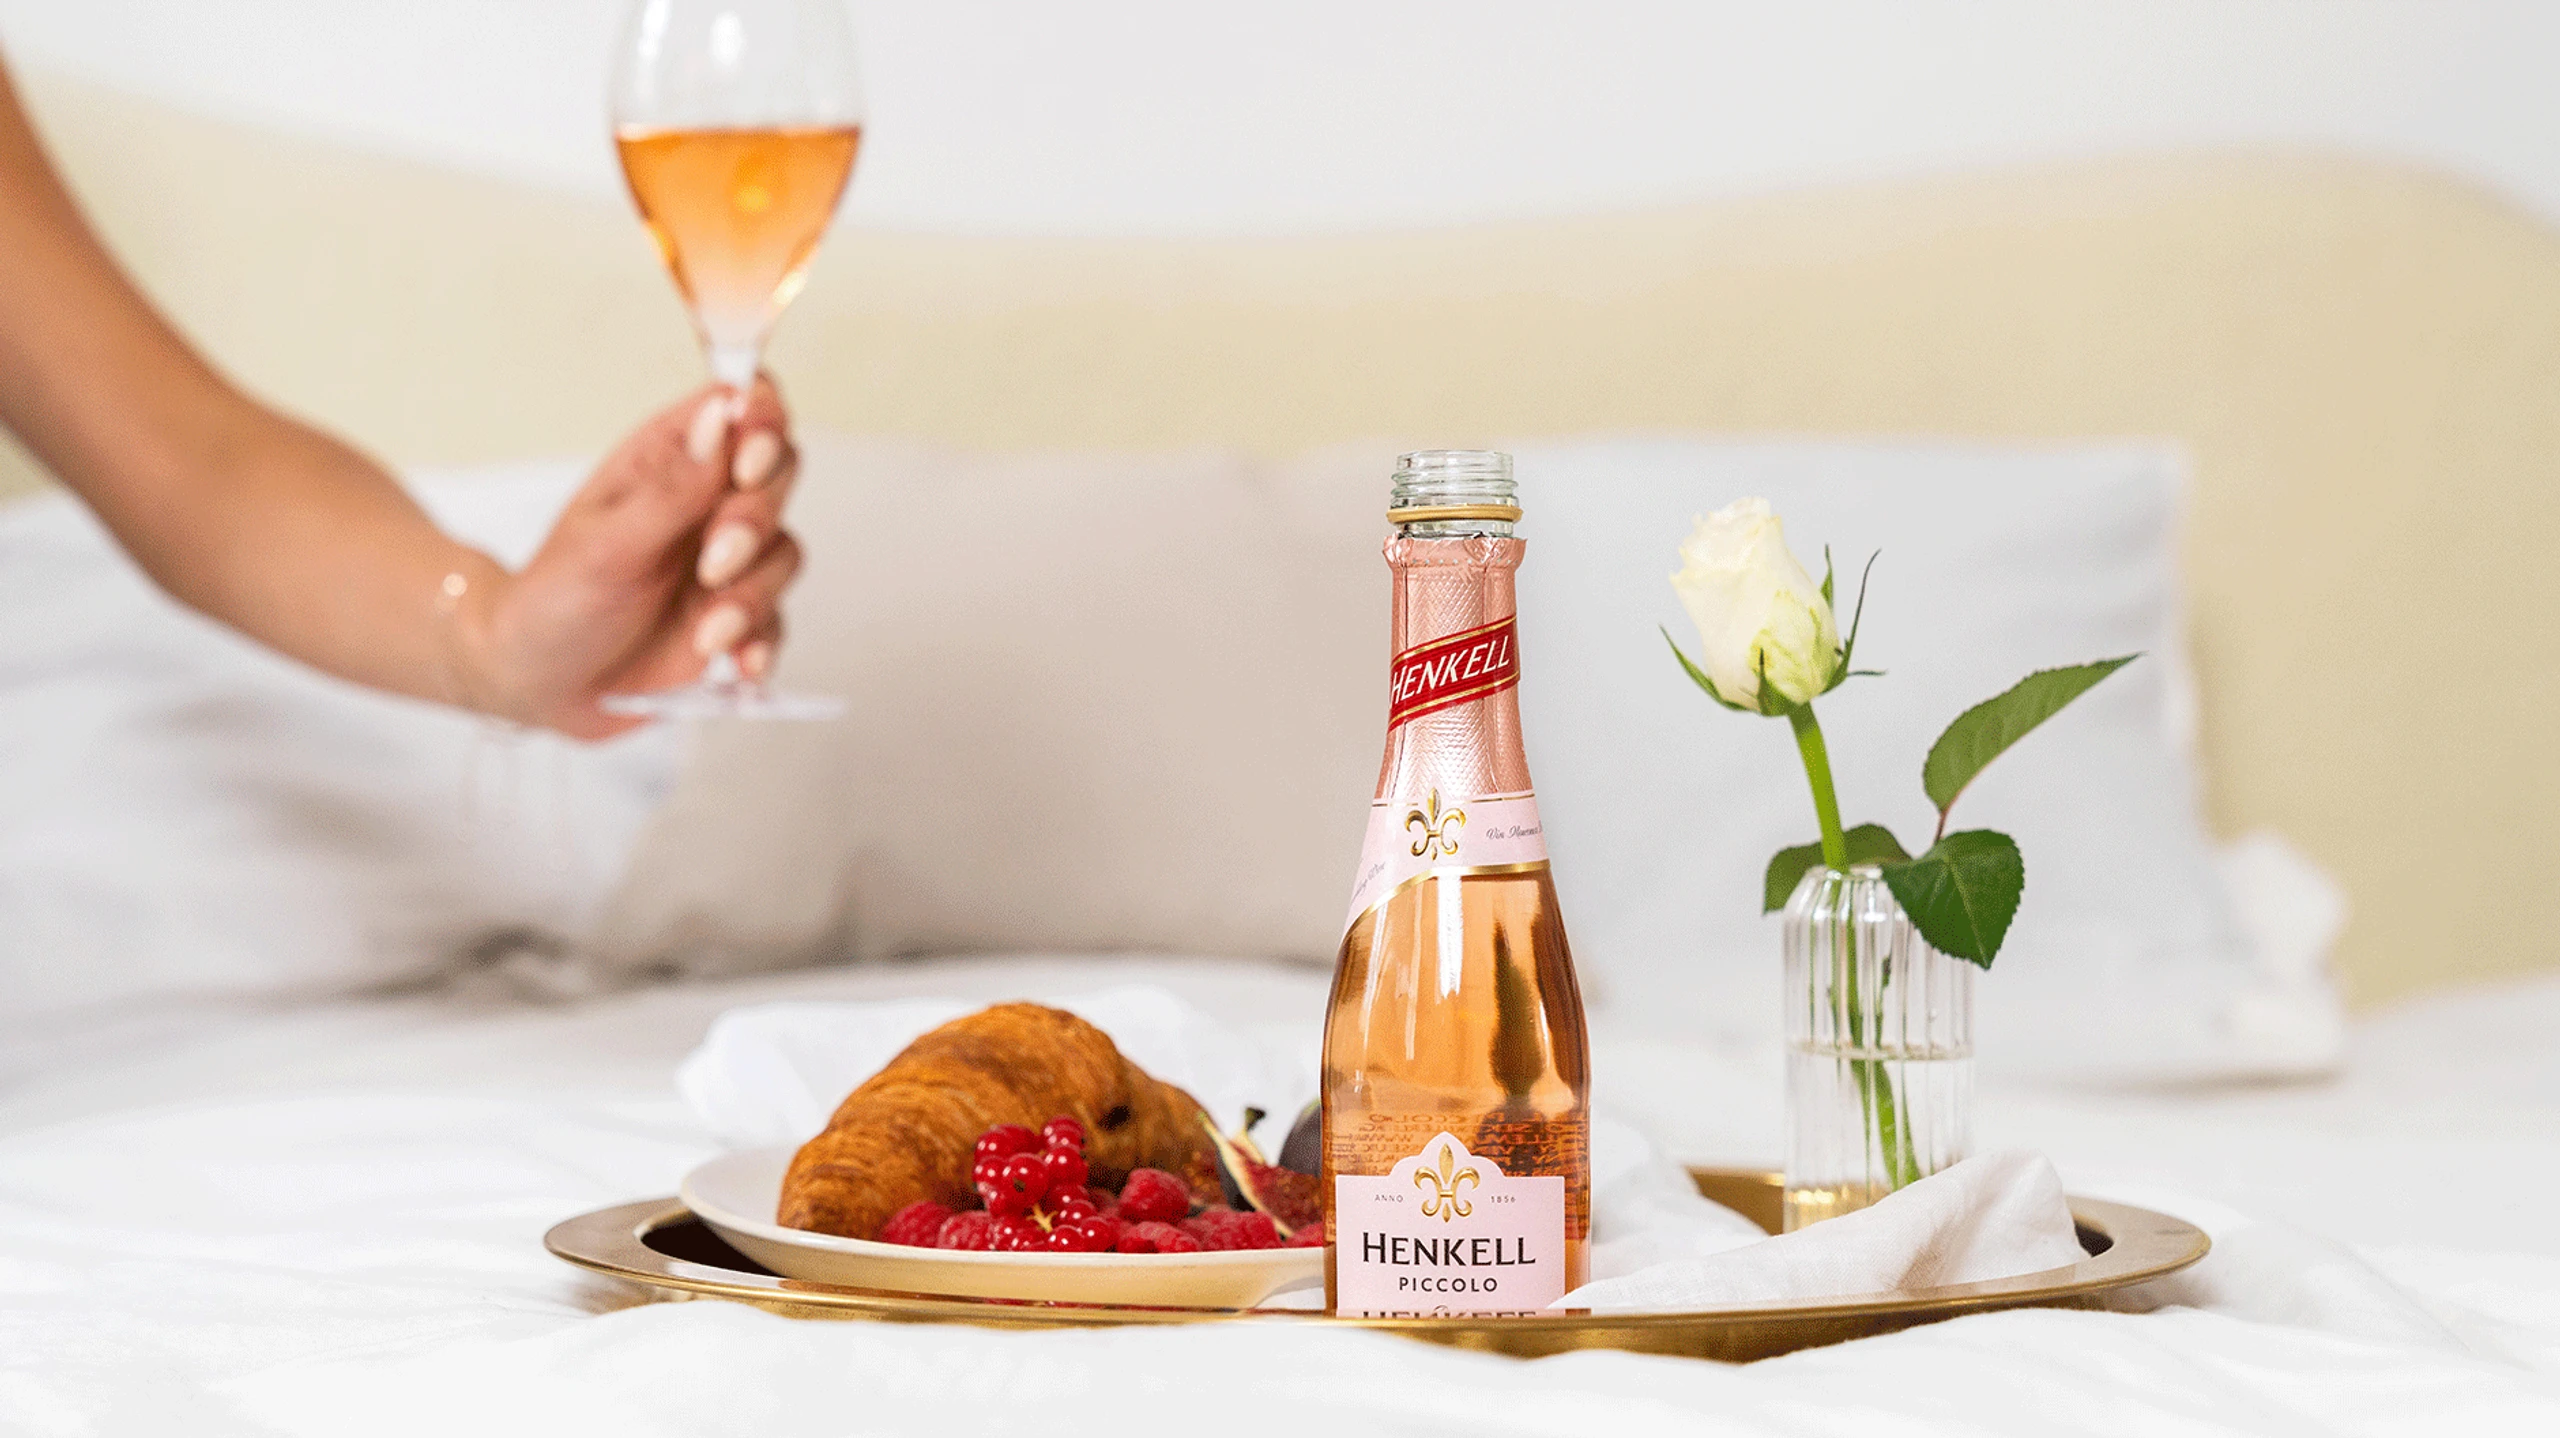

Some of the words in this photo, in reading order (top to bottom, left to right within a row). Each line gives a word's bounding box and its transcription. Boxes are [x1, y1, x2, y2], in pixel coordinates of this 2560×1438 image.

[1392, 635, 1509, 704] HENKELL
[1374, 1194, 1403, 1203] ANNO
[1491, 1195, 1516, 1204] 1856
[1362, 1232, 1536, 1266] HENKELL
[1399, 1277, 1498, 1292] PICCOLO
